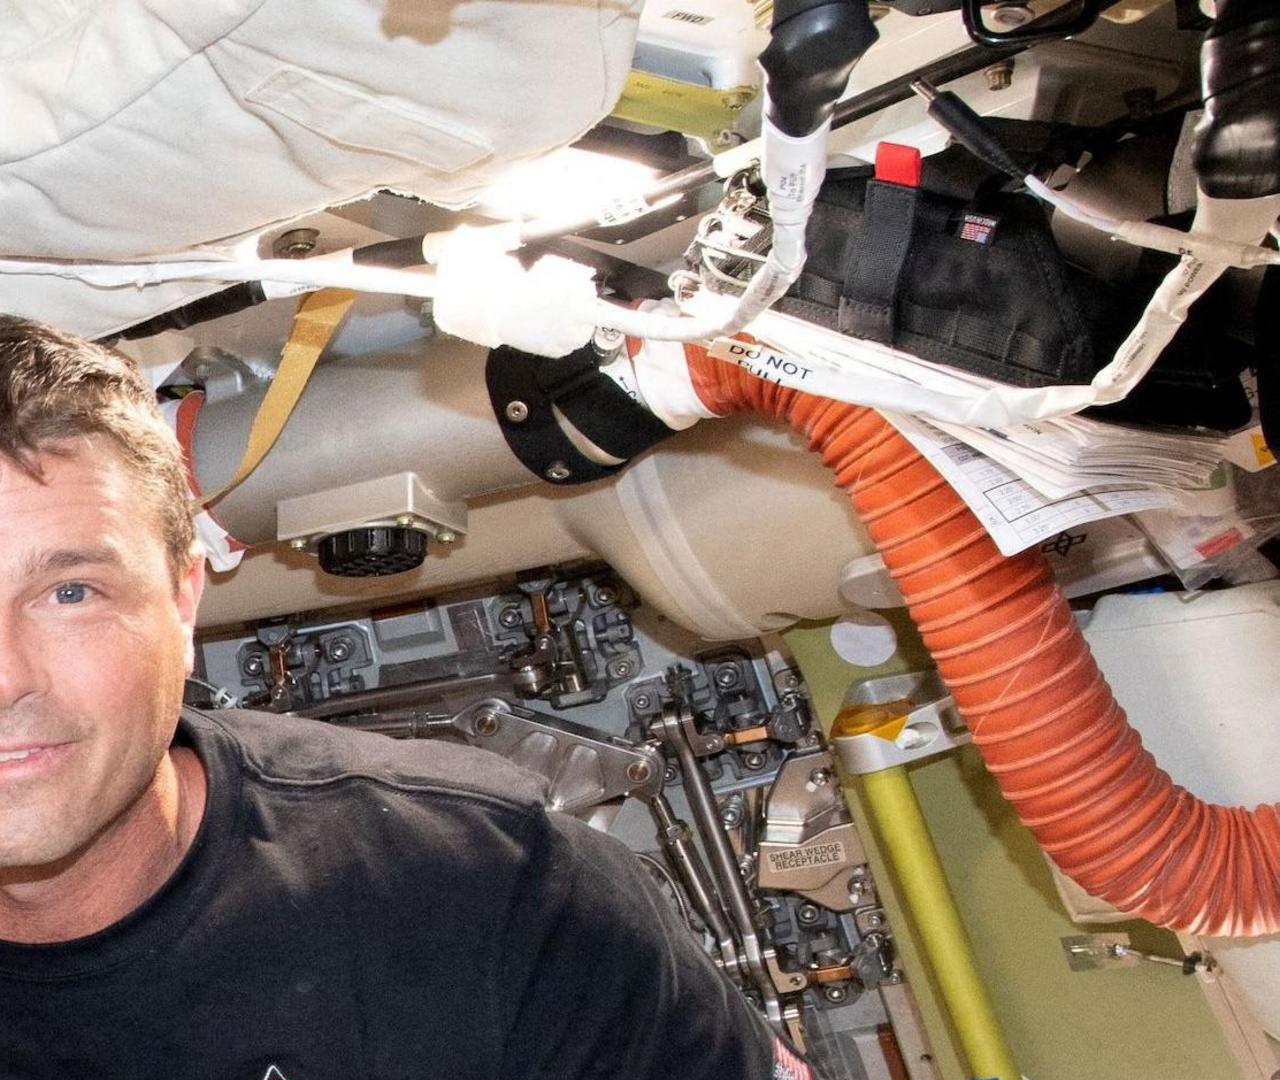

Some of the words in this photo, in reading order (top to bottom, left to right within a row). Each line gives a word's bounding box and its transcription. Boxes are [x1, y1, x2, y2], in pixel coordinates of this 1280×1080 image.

[672, 10, 705, 23] FWD
[729, 344, 761, 360] DO
[766, 355, 814, 380] NOT
[769, 849, 802, 862] SHEAR
[804, 843, 841, 856] WEDGE
[774, 852, 840, 871] RECEPTACLE
